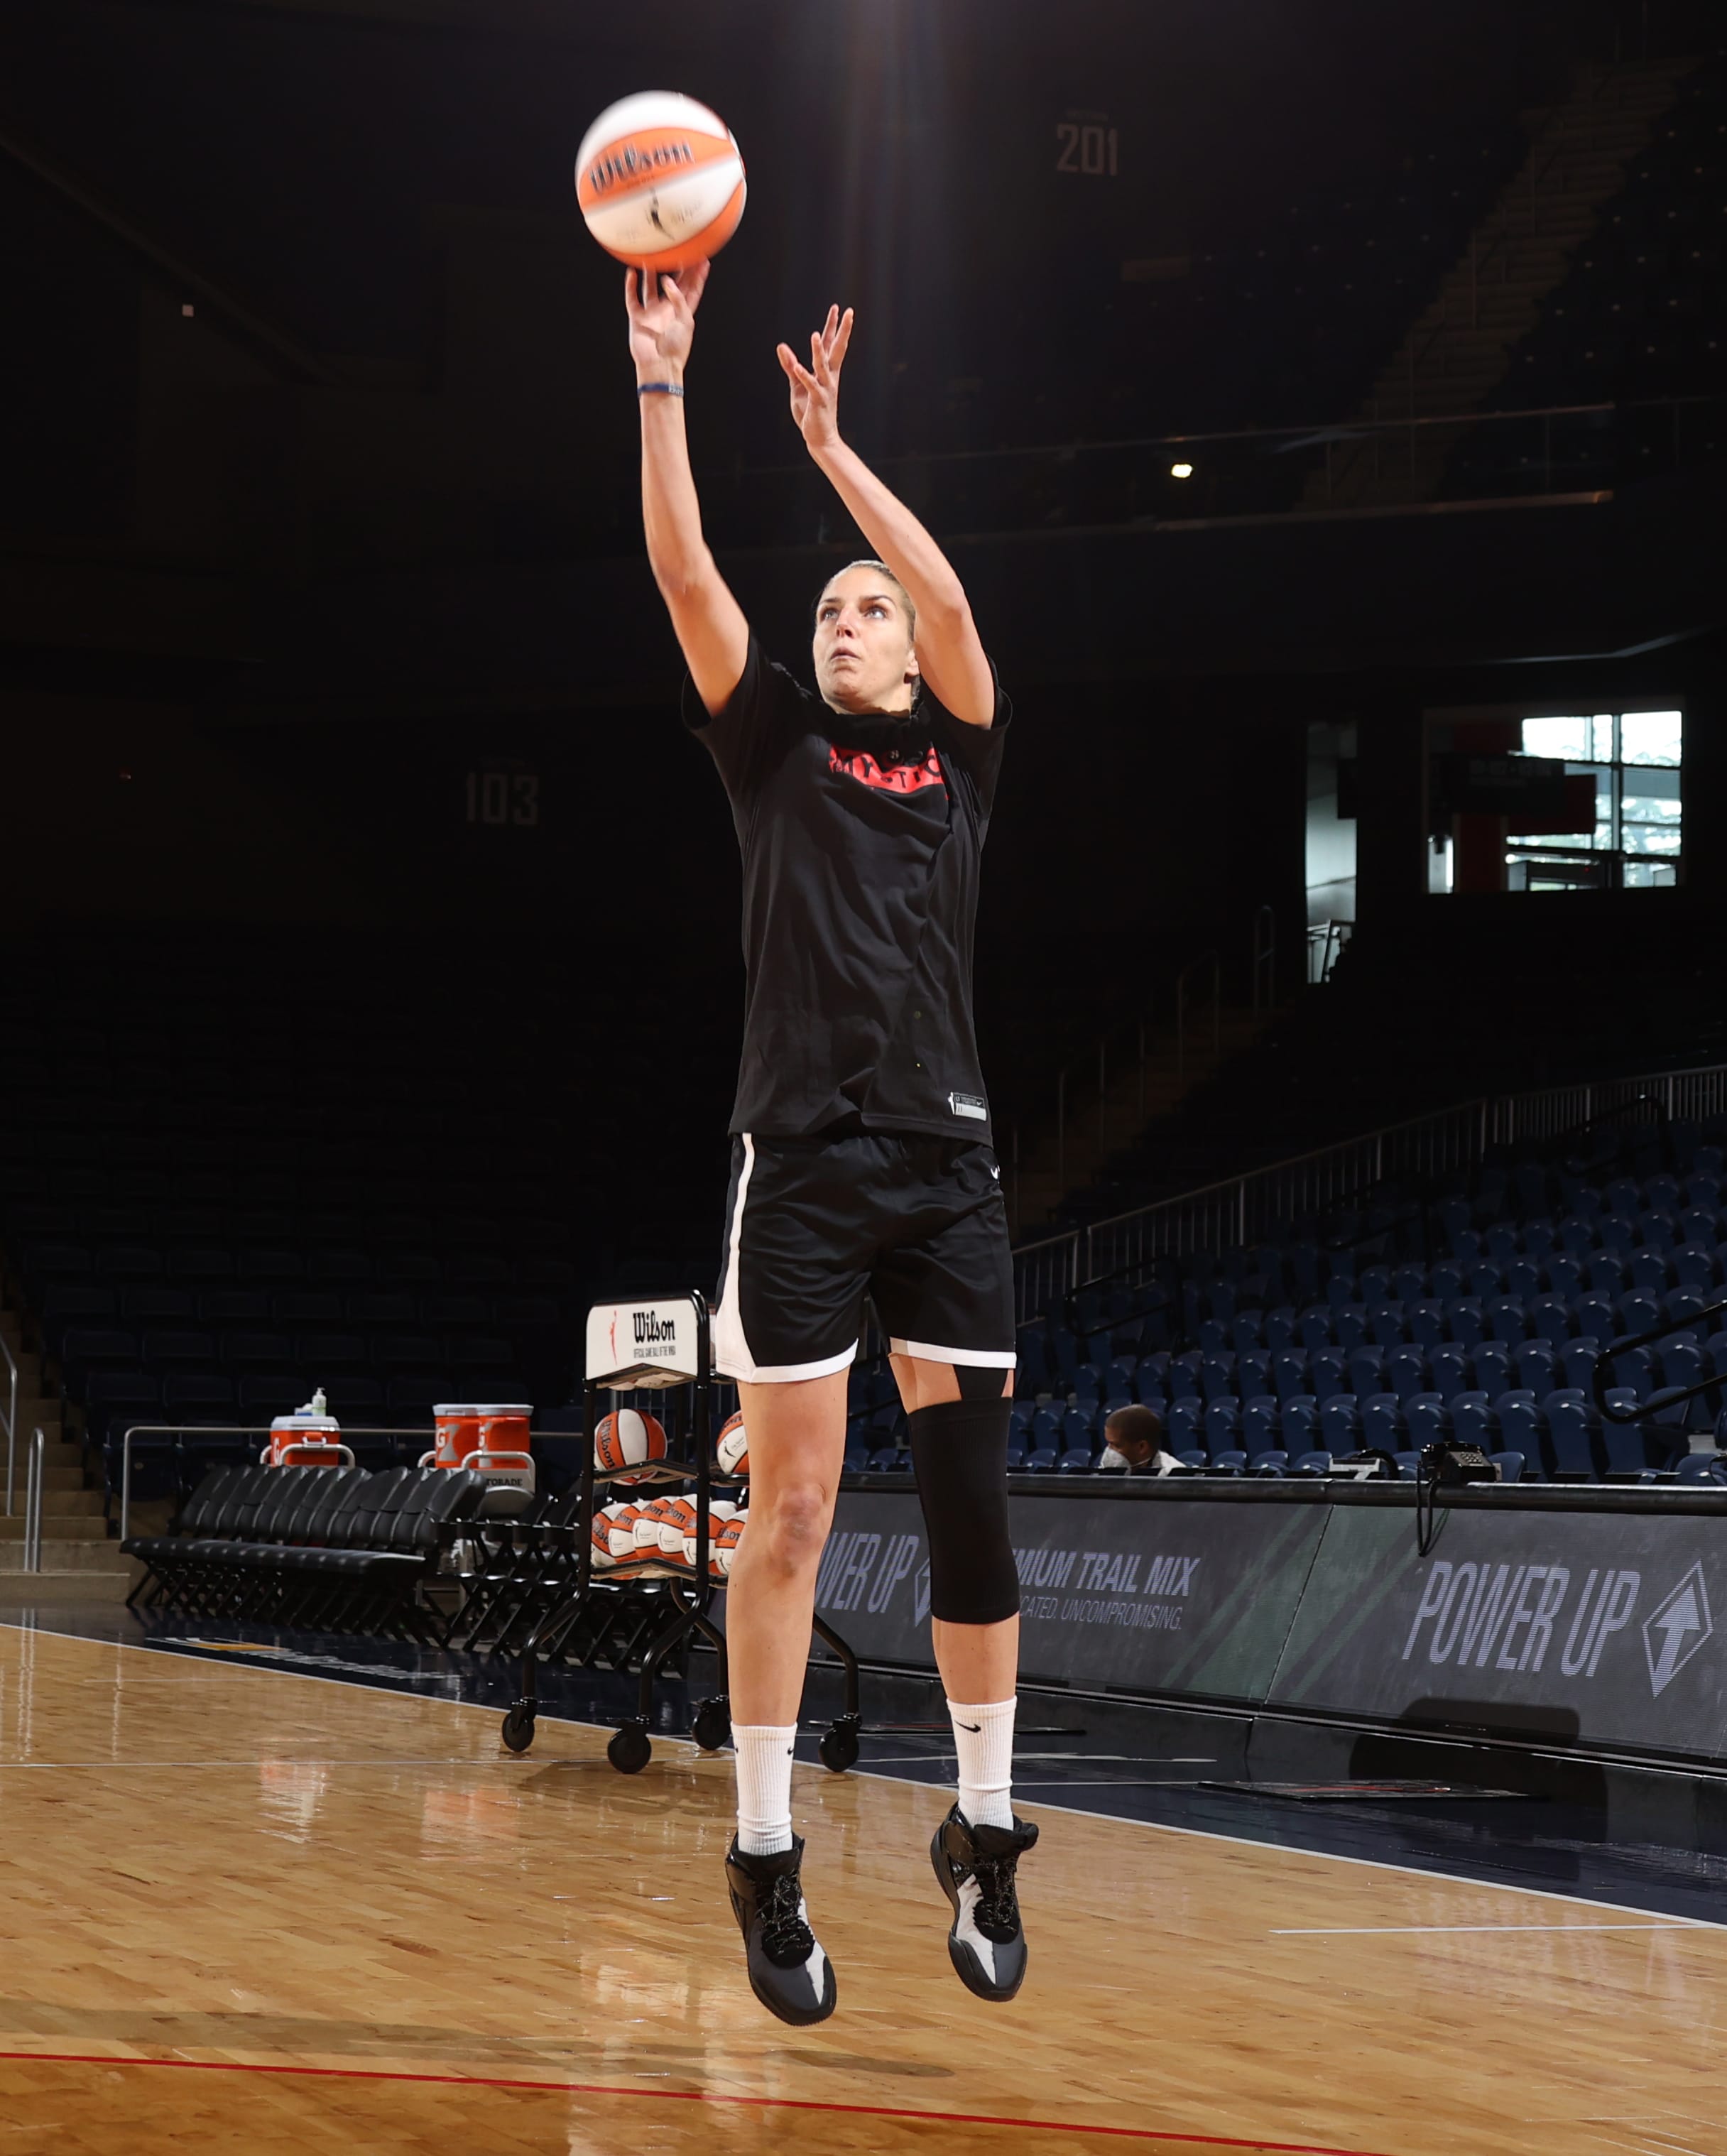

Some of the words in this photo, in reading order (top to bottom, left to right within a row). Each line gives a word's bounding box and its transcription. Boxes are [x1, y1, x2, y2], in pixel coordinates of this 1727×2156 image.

[589, 143, 695, 195] Wilson
[1057, 123, 1118, 176] 201
[467, 772, 540, 825] 103
[633, 1310, 675, 1343] Wilson
[486, 1478, 523, 1486] TORADE
[868, 1535, 920, 1613] UP
[1076, 1552, 1142, 1593] TRAIL
[1143, 1555, 1201, 1596] MIX
[1402, 1562, 1571, 1672] POWER
[1562, 1569, 1641, 1677] UP
